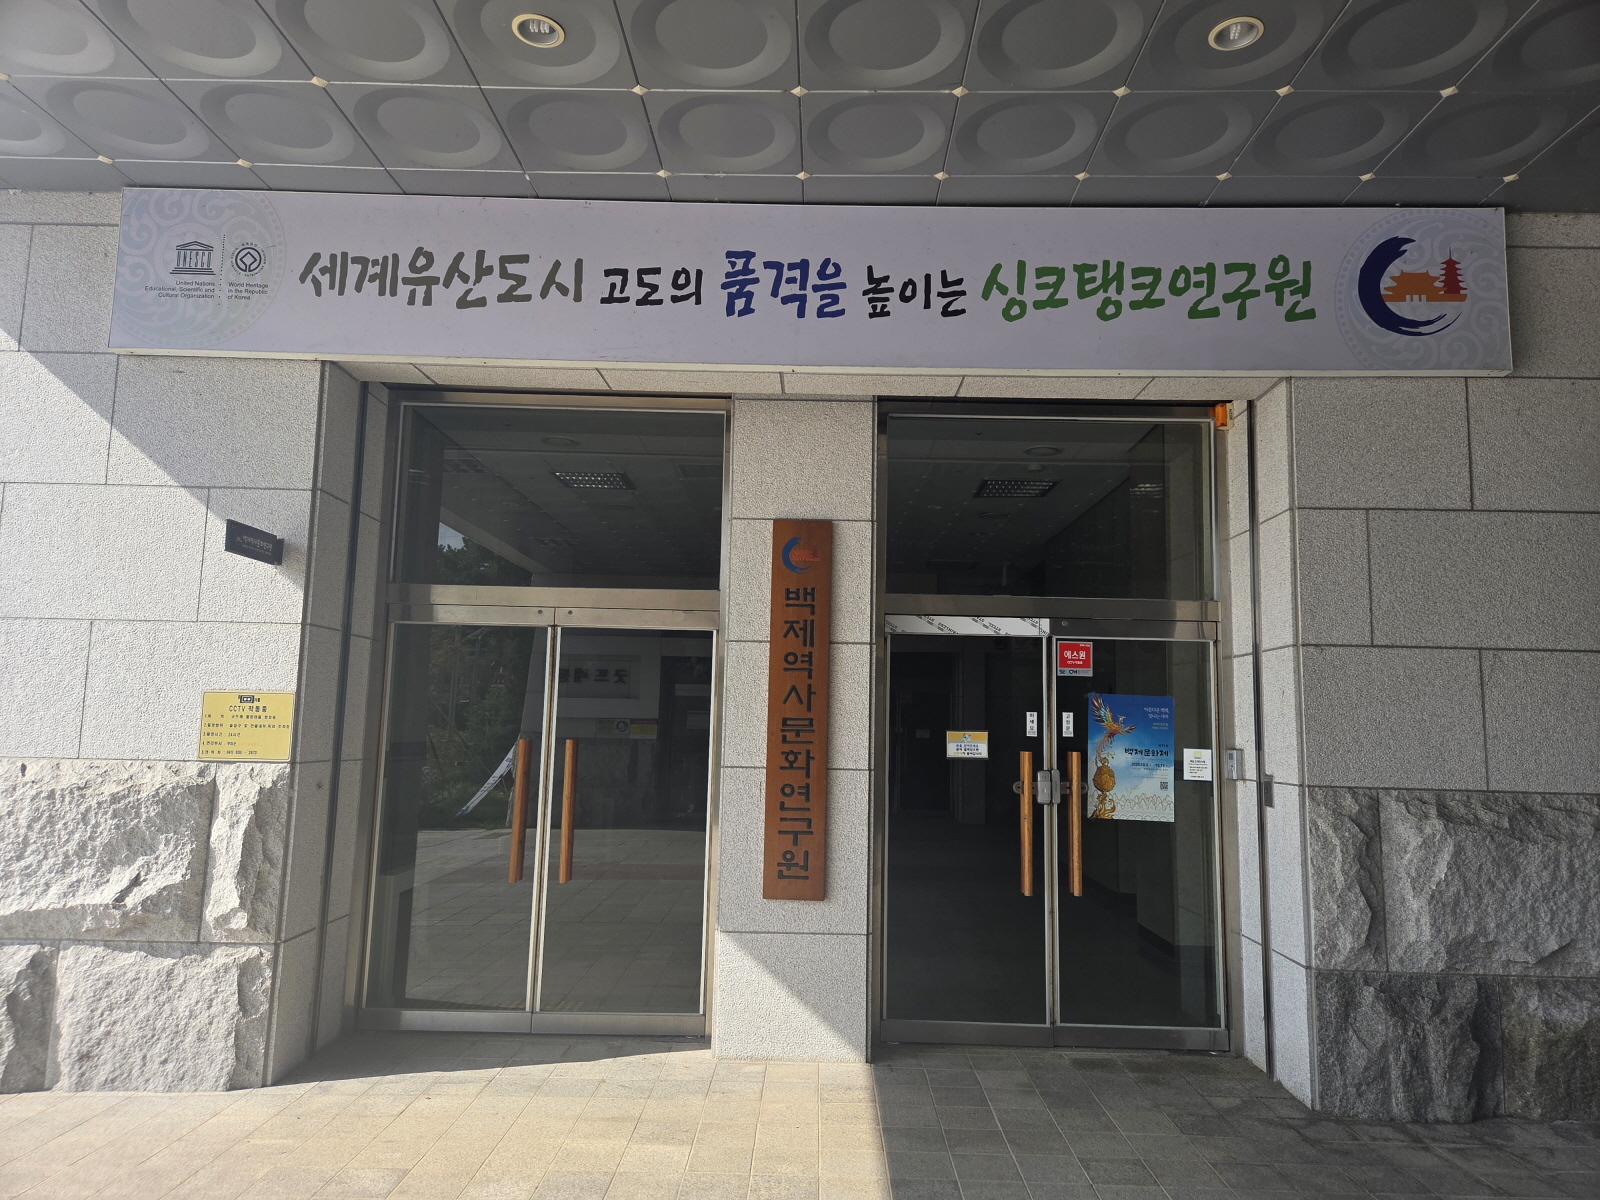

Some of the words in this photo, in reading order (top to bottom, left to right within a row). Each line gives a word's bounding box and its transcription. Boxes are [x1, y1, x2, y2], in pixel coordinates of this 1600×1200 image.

[176, 250, 212, 268] UNESCO
[299, 246, 584, 310] 세계유산도시
[600, 267, 703, 306] 고도의
[720, 250, 848, 319] 품격을
[862, 265, 967, 319] 높이는
[981, 254, 1317, 322] 싱크탱크연구원
[1063, 650, 1086, 660] 에스원
[248, 705, 267, 713] 작동중
[777, 586, 817, 880] 백제역사문화연구원
[1124, 747, 1169, 757] 백제문화제
